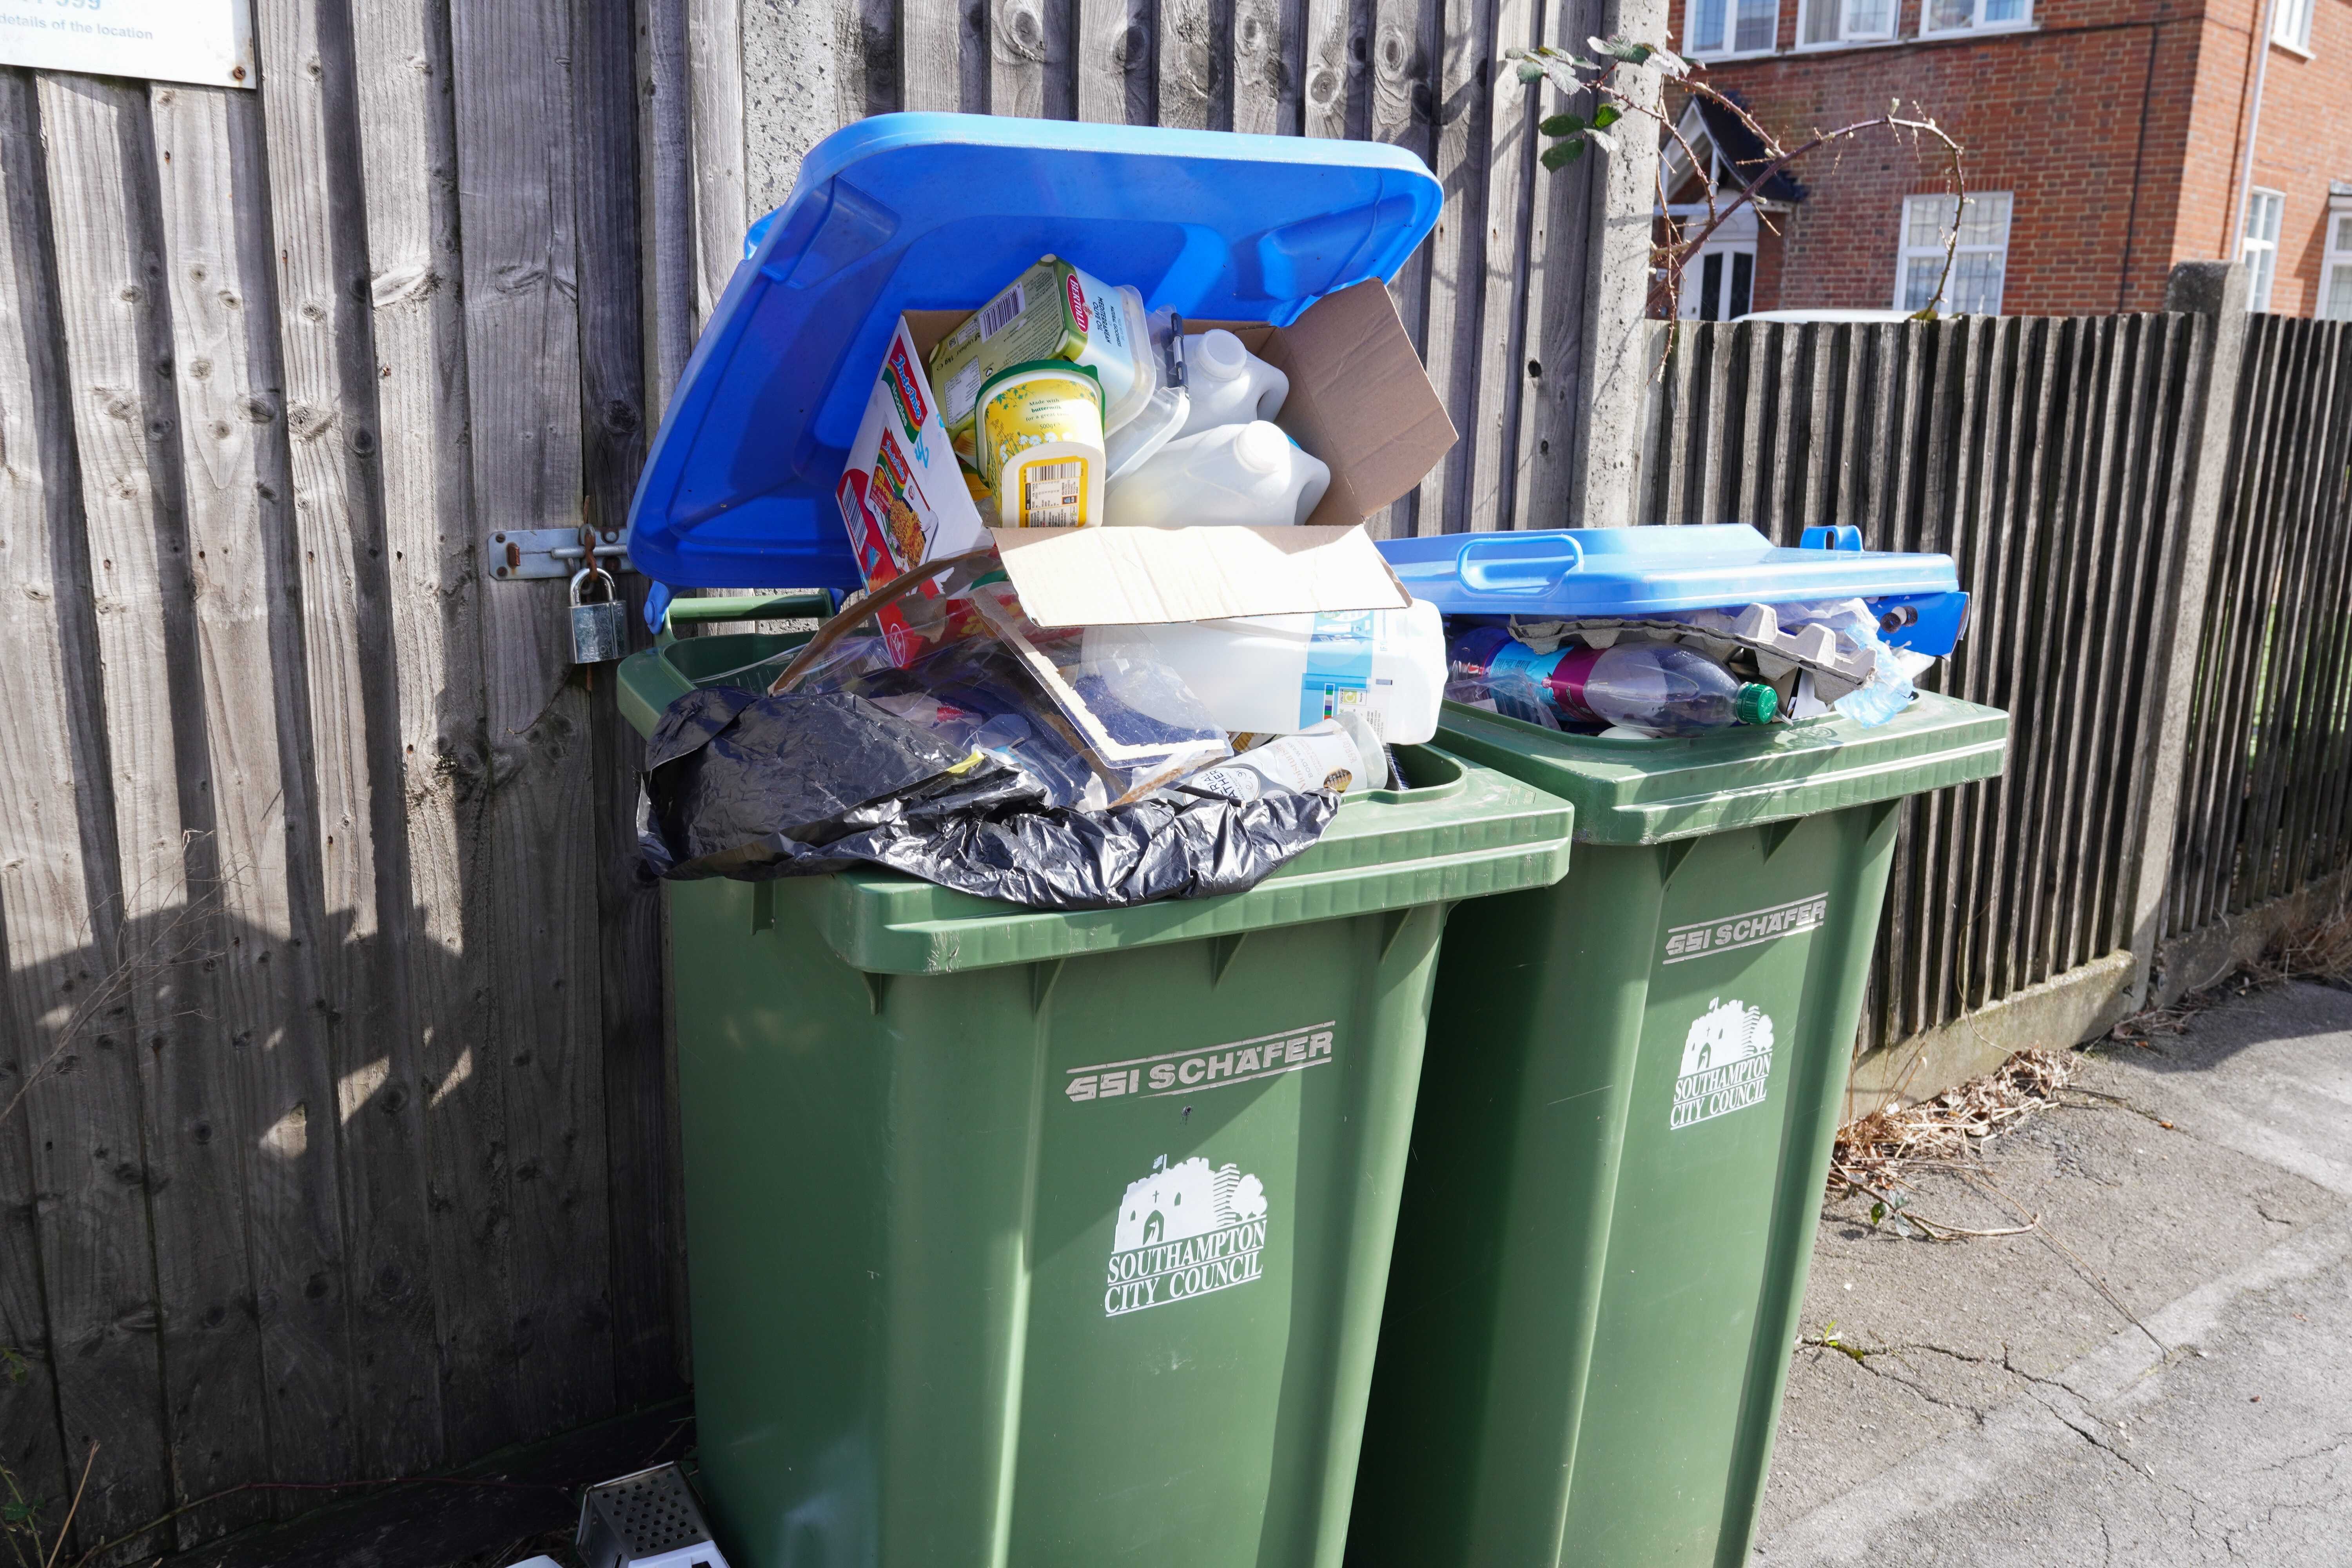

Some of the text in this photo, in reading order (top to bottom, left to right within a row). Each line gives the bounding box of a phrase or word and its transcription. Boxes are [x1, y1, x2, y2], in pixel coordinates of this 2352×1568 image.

[0, 13, 153, 40] details of the location
[1070, 279, 1086, 329] BERTOLLI
[1098, 296, 1112, 344] MEDITERRANEAN
[956, 337, 973, 356] Upfield
[891, 353, 921, 420] Indomie
[892, 383, 907, 426] Noodles
[1210, 769, 1238, 798] ATHER
[1301, 759, 1313, 778] BODY
[1715, 900, 1826, 945] SCHÄFER
[1149, 1031, 1333, 1089] SCHÄFER
[1674, 1053, 1772, 1103] SOUTHAMPTON
[1670, 1078, 1767, 1127] CITY COUNCIL
[1107, 1220, 1267, 1283] SOUTHAMPTON
[1105, 1251, 1263, 1314] CITY COUNCIL
